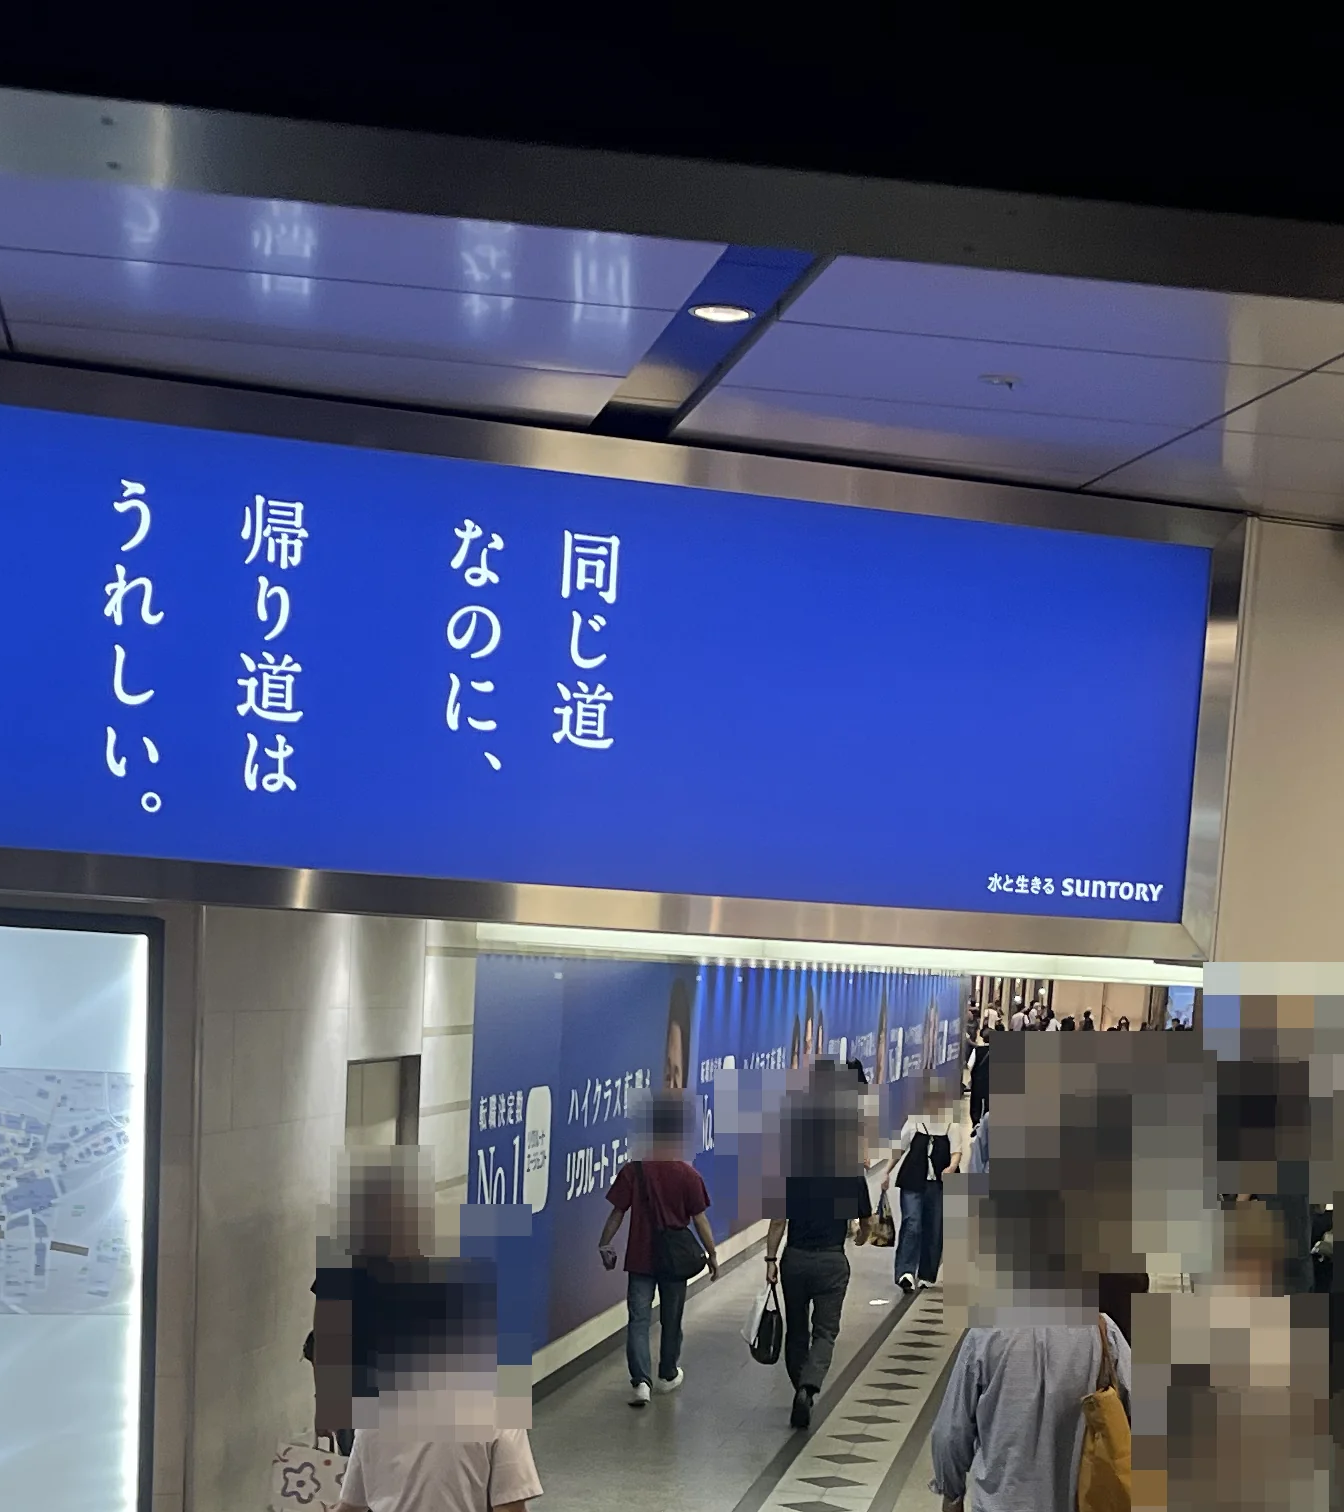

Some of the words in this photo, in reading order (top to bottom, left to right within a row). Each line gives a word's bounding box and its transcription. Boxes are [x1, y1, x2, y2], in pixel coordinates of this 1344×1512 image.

[103, 479, 164, 813] うれしい。
[236, 495, 309, 793] 帰り道は
[446, 518, 505, 771] なのに、
[552, 530, 620, 749] 同じ道
[987, 872, 1054, 895] 水と生きる
